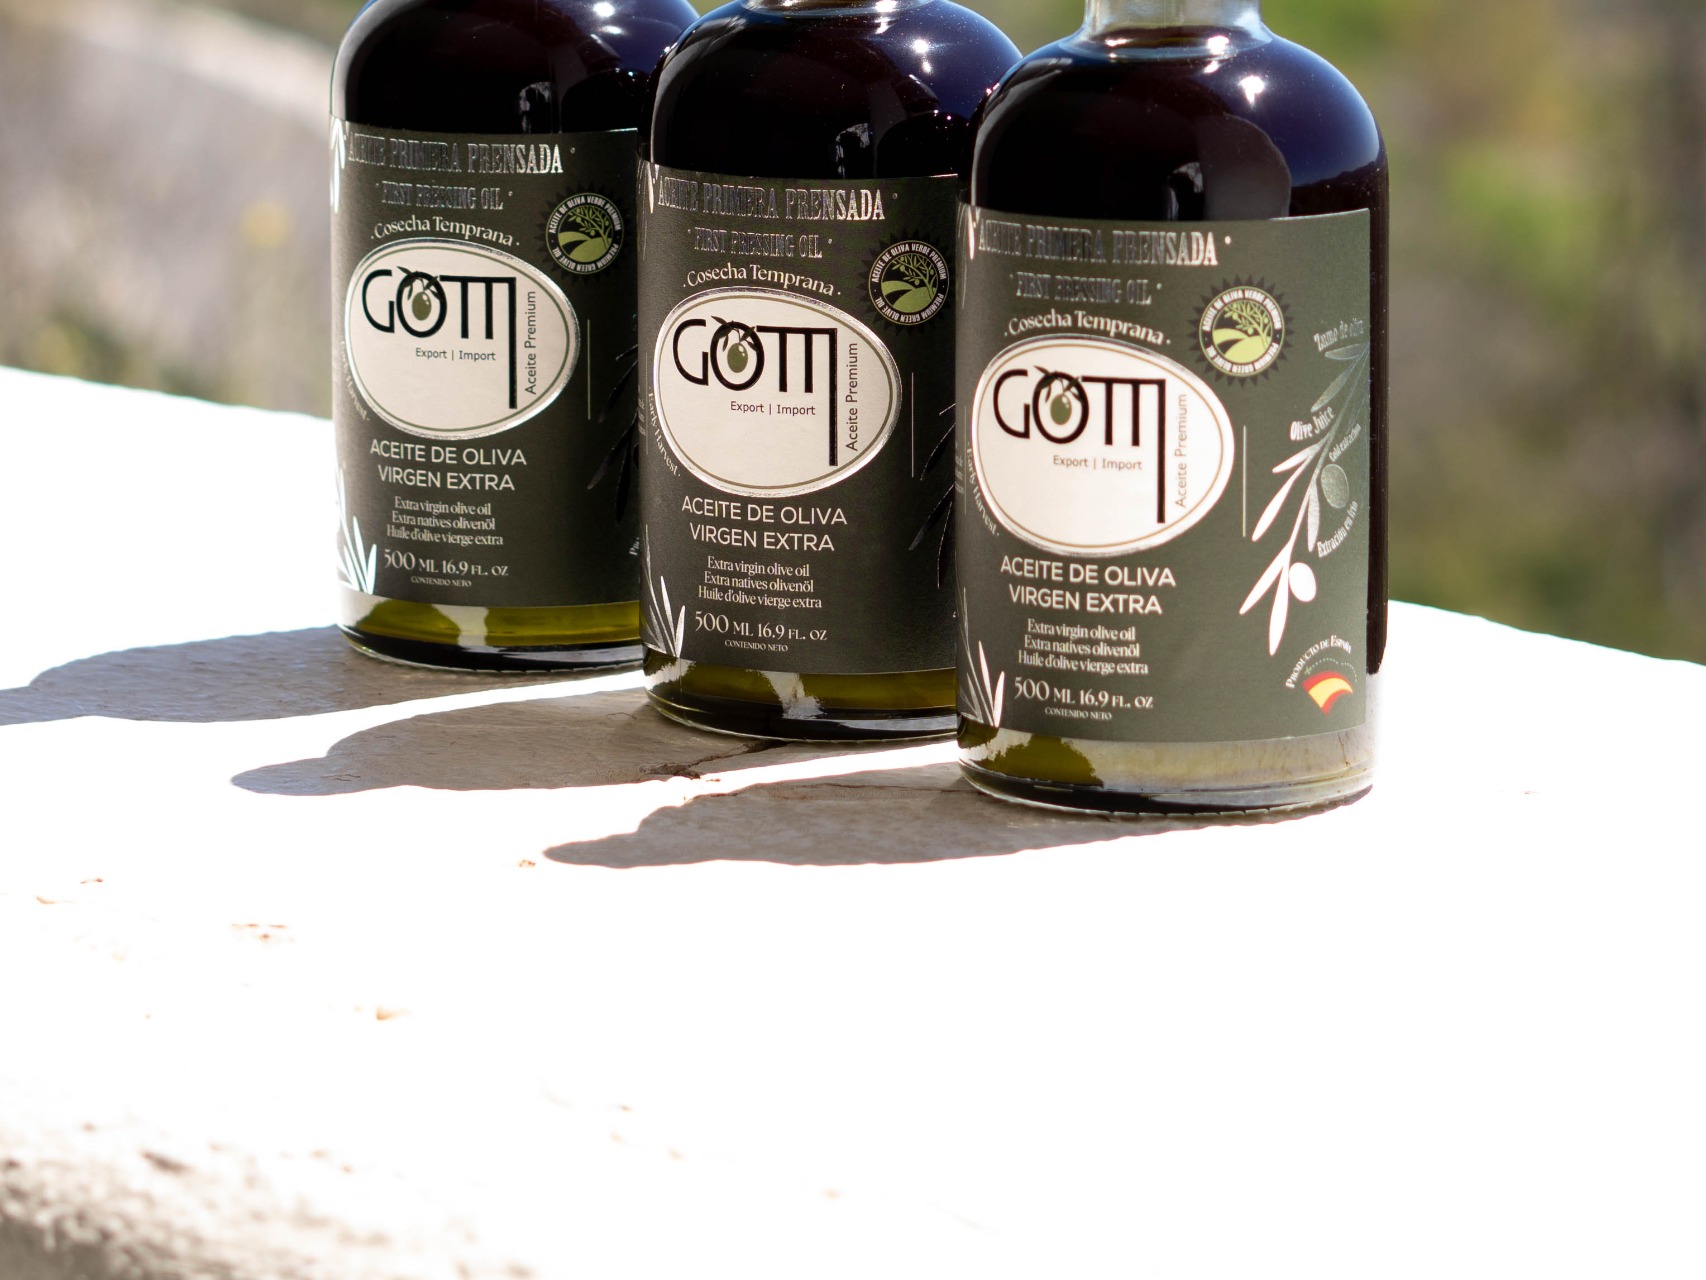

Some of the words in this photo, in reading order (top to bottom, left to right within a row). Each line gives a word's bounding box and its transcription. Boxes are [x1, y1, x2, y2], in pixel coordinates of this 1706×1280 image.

[467, 143, 564, 174] PRENSADA
[480, 187, 504, 210] OIL
[702, 182, 780, 219] PRIMERA
[785, 188, 885, 220] PRENSADA
[548, 212, 562, 234] ACEITE
[559, 204, 568, 214] DE
[566, 196, 586, 208] OLIVA
[587, 196, 606, 208] VERDE
[604, 202, 622, 230] PREMIUM
[374, 214, 430, 239] Cosecha
[433, 216, 513, 247] Temprana
[596, 243, 619, 268] PREMIUM
[800, 234, 822, 258] OIL
[1112, 230, 1218, 266] PRENSADA
[560, 255, 576, 270] OLIVE
[576, 263, 596, 272] GREEN
[872, 261, 886, 282] ACEITE
[882, 252, 892, 262] DE
[890, 244, 910, 256] OLIVA
[912, 243, 932, 255] VERDE
[929, 251, 947, 280] PREMIUM
[687, 262, 747, 287] Cosecha
[750, 264, 834, 296] Temprana
[1126, 278, 1152, 306] OIL
[875, 296, 884, 308] OIL
[882, 306, 900, 320] OLIVE
[920, 293, 944, 320] PREMIUM
[1202, 306, 1218, 332] ACEITE
[1214, 298, 1224, 310] DE
[1222, 289, 1244, 304] OLIVA
[524, 291, 536, 349] Premium
[900, 314, 920, 322] GREEN
[1008, 308, 1072, 336] Cosecha
[1074, 310, 1164, 345] Temprana
[415, 348, 448, 360] Export
[459, 350, 496, 362] Import
[524, 352, 536, 395] Aceite
[846, 343, 858, 404] Premium
[730, 400, 764, 414] Export
[776, 404, 816, 416] Import
[846, 406, 858, 452] Aceite
[1174, 394, 1187, 456] Premium
[1290, 420, 1312, 440] Olive
[1313, 406, 1334, 434] Juice
[370, 438, 426, 462] ACEITE
[431, 446, 458, 464] DE
[462, 448, 527, 466] OLIVA
[654, 428, 678, 476] Harvest
[1052, 454, 1089, 468] Export
[1102, 458, 1142, 472] Import
[378, 464, 442, 488] VIRGEN
[446, 472, 515, 490] EXTRA
[1174, 460, 1187, 508] Aceite
[394, 496, 420, 511] Extra
[418, 498, 449, 514] virgin
[450, 501, 476, 516] olive
[477, 503, 492, 516] oil
[682, 496, 742, 520] ACEITE
[747, 504, 774, 522] DE
[780, 506, 848, 525] OLIVA
[392, 511, 416, 526] Extra
[417, 514, 452, 529] natives
[452, 516, 496, 530] olivenöl
[1344, 516, 1354, 530] en
[386, 524, 410, 540] Huile
[442, 530, 474, 546] vierge
[475, 532, 504, 546] extra
[690, 522, 758, 547] VIRGEN
[763, 532, 834, 552] EXTRA
[384, 548, 416, 570] 500
[418, 560, 438, 573] ML
[442, 560, 468, 575] 16.9
[491, 565, 508, 576] OZ
[708, 556, 734, 571] Extra
[734, 560, 766, 576] virgin
[766, 562, 794, 576] olive
[794, 563, 810, 577] oil
[1000, 555, 1063, 582] ACEITE
[1069, 563, 1098, 584] DE
[1104, 566, 1176, 587] OLIVA
[410, 576, 450, 586] CONTENIDO
[452, 579, 472, 587] NETO
[704, 571, 730, 586] Extra
[732, 576, 768, 590] natives
[769, 578, 814, 592] olivenöl
[698, 586, 724, 602] Huile
[724, 589, 756, 605] d'olive
[757, 594, 792, 609] vierge
[792, 596, 822, 608] extra
[1008, 584, 1080, 610] VIRGEN
[1086, 592, 1162, 614] EXTRA
[694, 612, 729, 634] 500
[732, 623, 754, 637] ML
[758, 623, 784, 640] 16.9
[788, 628, 806, 640] FL.
[810, 629, 827, 641] OZ
[1027, 618, 1054, 634] Extra
[1056, 622, 1088, 639] virgin
[1090, 624, 1118, 640] olive
[1120, 626, 1136, 640] oil
[724, 639, 766, 650] CONTENIDO
[768, 643, 788, 652] NETO
[1024, 634, 1052, 650] Extra
[1052, 640, 1091, 655] natives
[1092, 642, 1140, 658] olivenöl
[1018, 650, 1044, 666] Huile
[1080, 658, 1116, 675] vierge
[1116, 661, 1148, 675] extra
[1286, 644, 1320, 688] PRODUCTO
[1320, 639, 1330, 650] DE
[1014, 677, 1050, 700] 500
[1052, 688, 1074, 704] ML
[1079, 688, 1109, 708] 16.9
[1112, 695, 1131, 708] FL.
[1134, 696, 1154, 709] OZ
[1044, 706, 1088, 718] CONTENIDO
[1090, 711, 1112, 720] NETO
